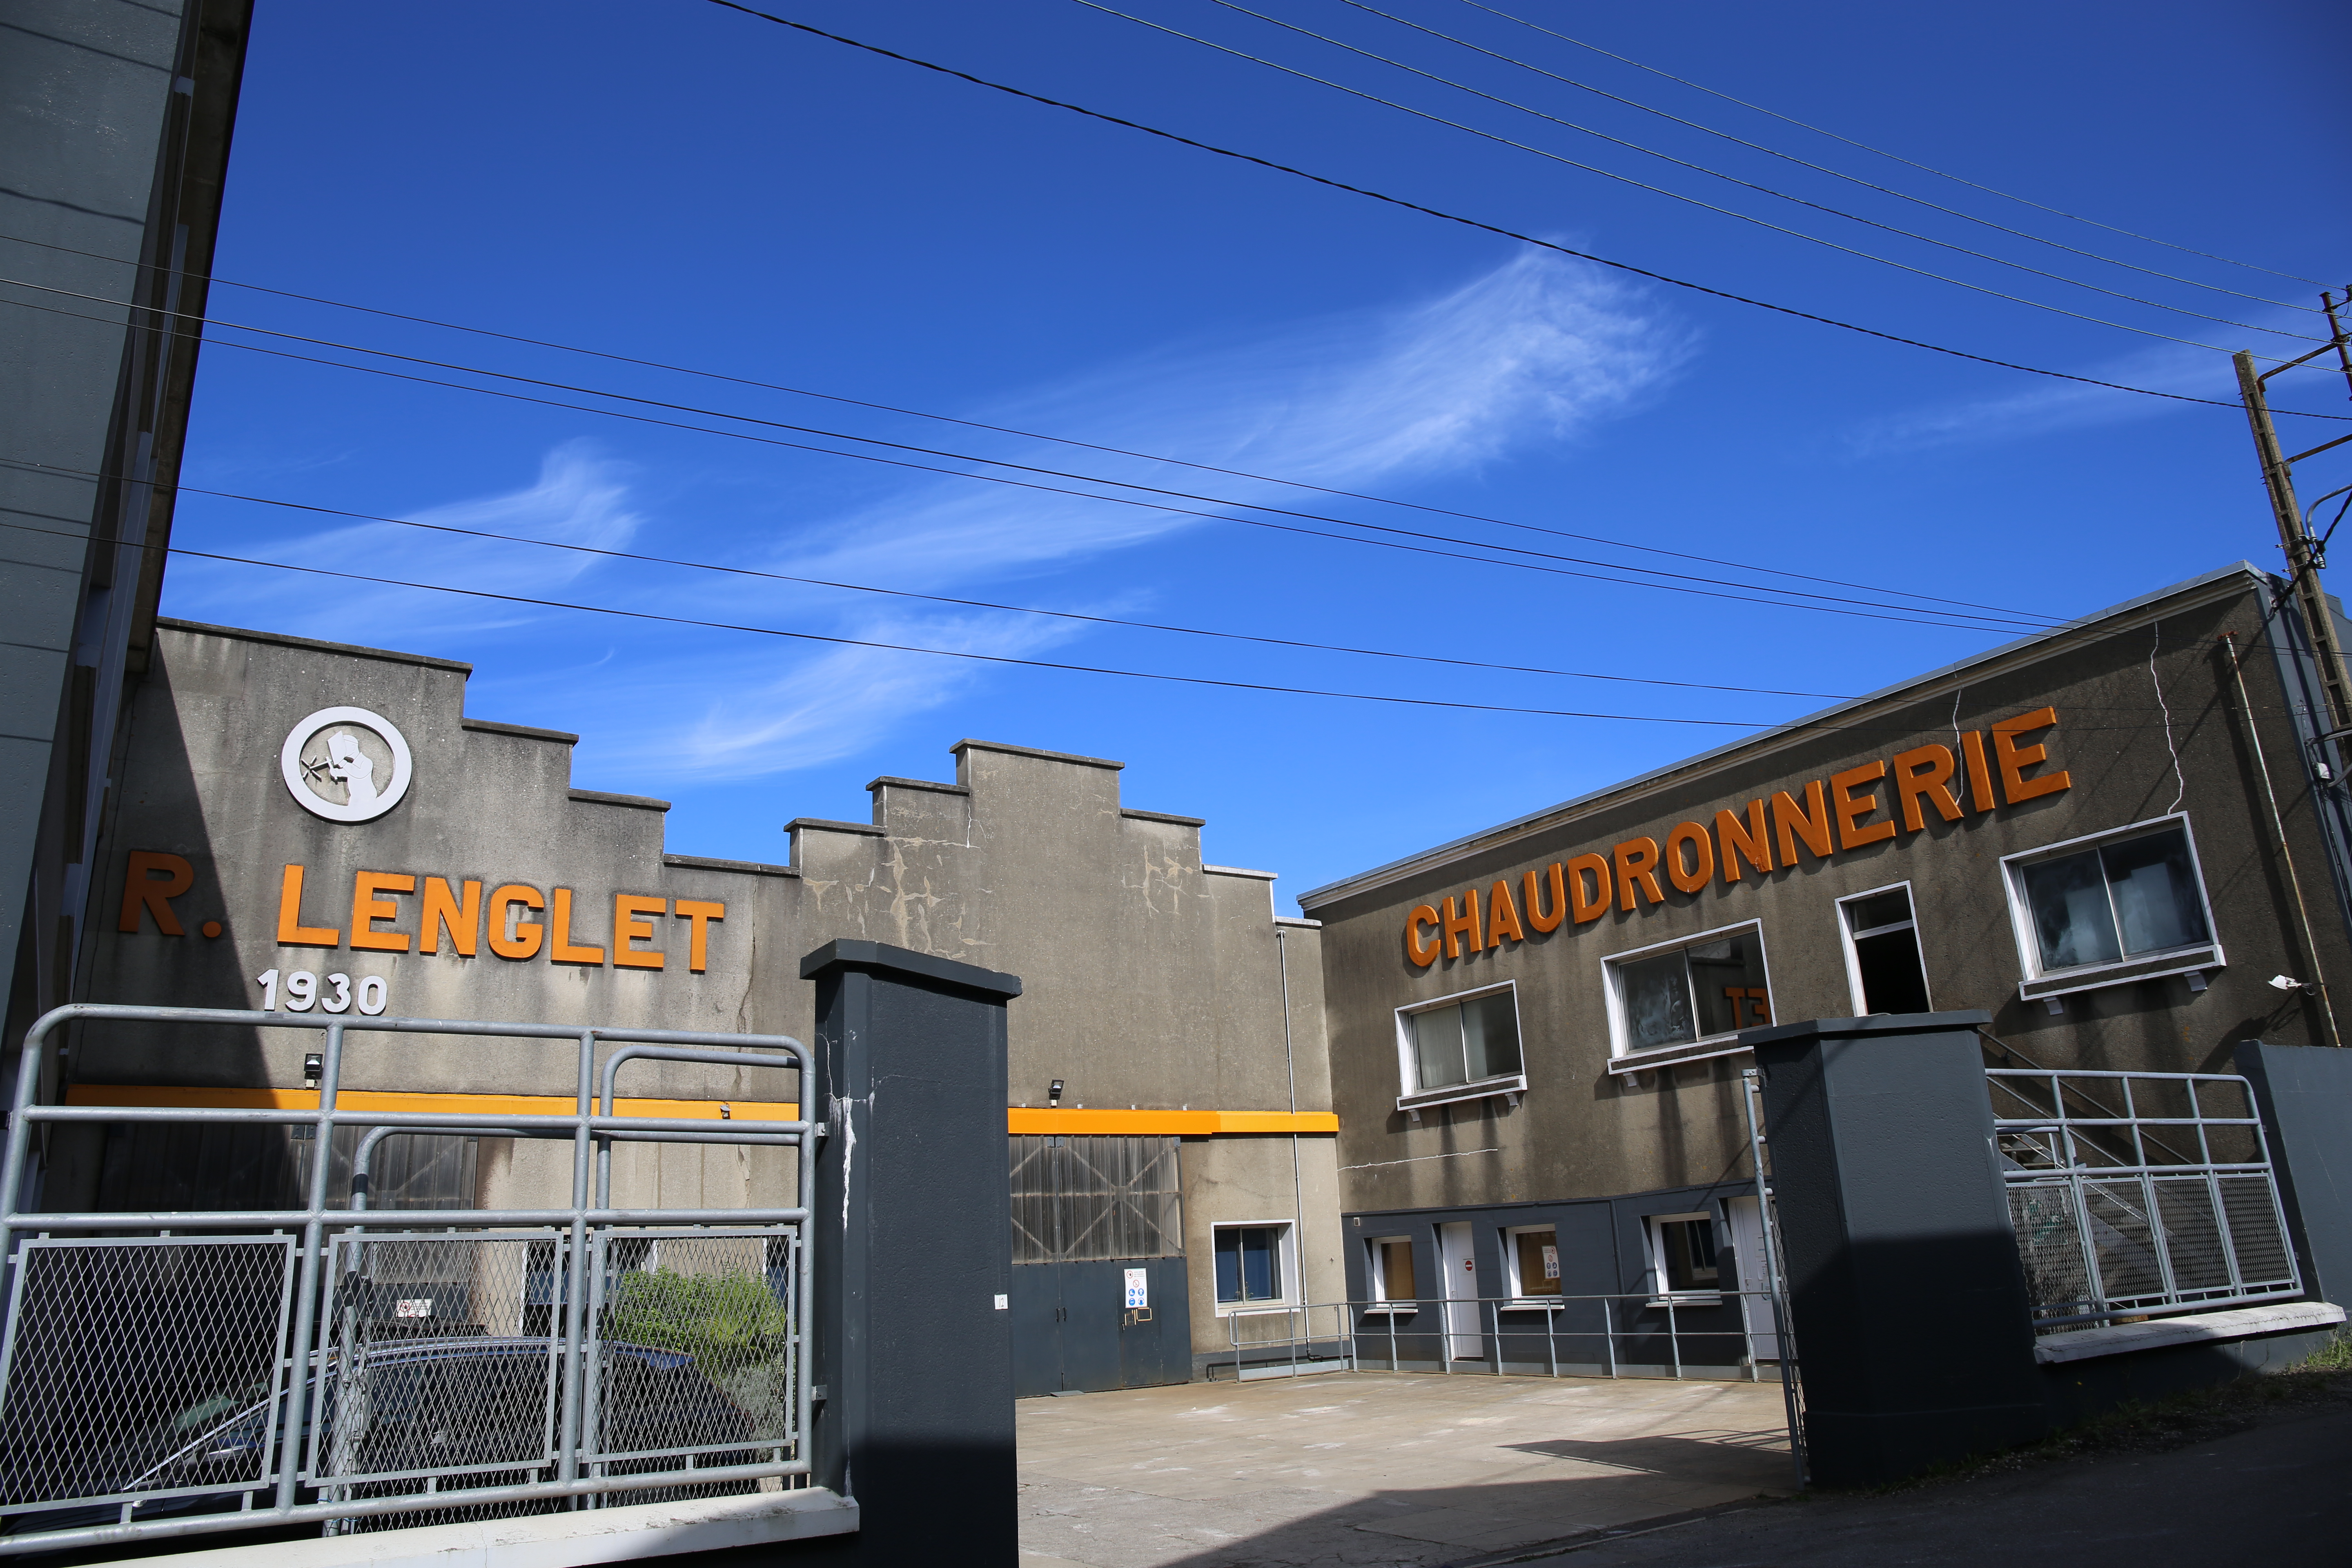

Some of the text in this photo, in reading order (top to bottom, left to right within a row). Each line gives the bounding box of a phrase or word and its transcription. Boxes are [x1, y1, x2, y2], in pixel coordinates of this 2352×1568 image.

[1405, 706, 2072, 968] CHAUDRONNERIE
[118, 850, 724, 972] R. LENGLET
[257, 969, 388, 1015] 1930
